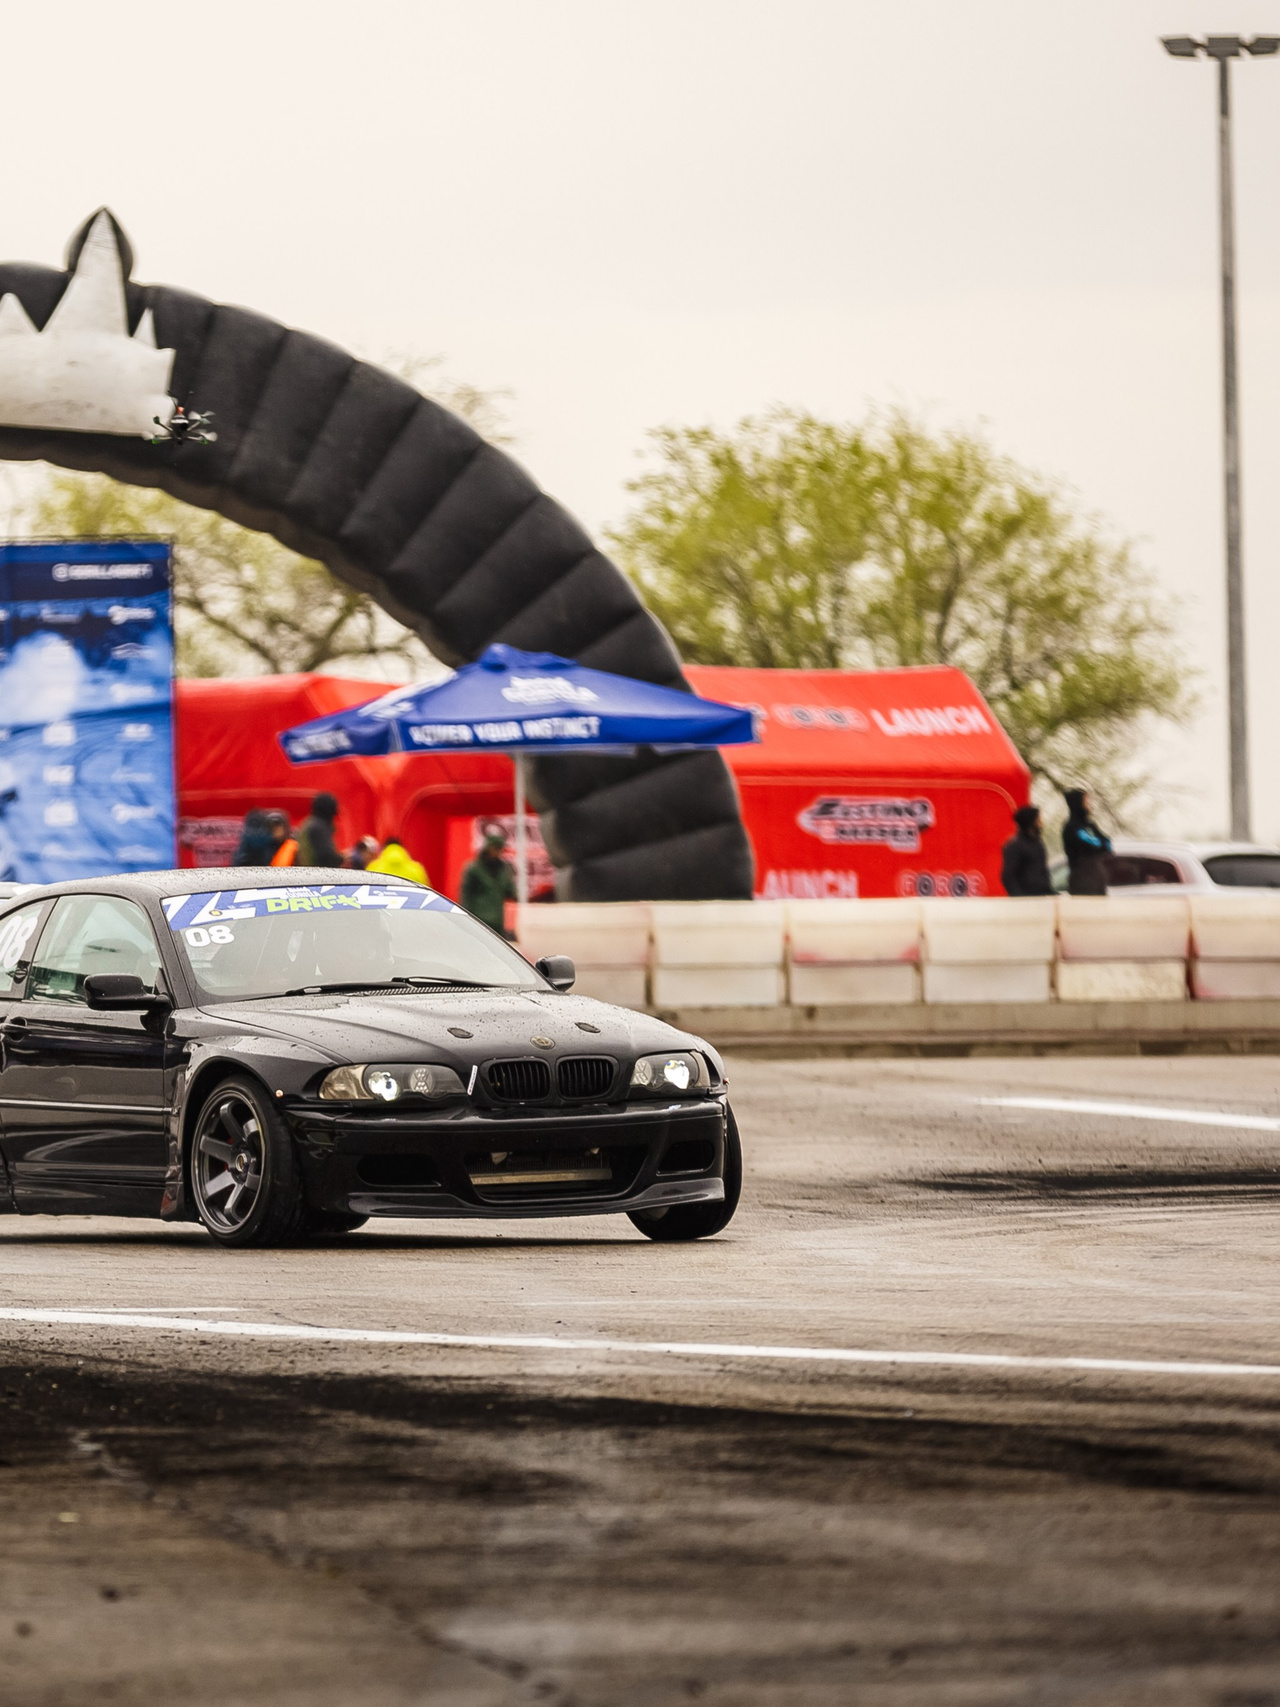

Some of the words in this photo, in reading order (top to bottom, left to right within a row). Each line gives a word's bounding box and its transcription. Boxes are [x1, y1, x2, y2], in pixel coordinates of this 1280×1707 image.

[473, 720, 522, 743] YOUR
[521, 716, 602, 739] INSTINCT
[870, 705, 992, 737] LAUNCH
[754, 869, 859, 899] AUNCH
[266, 895, 362, 913] DRIFT
[184, 924, 235, 948] 08
